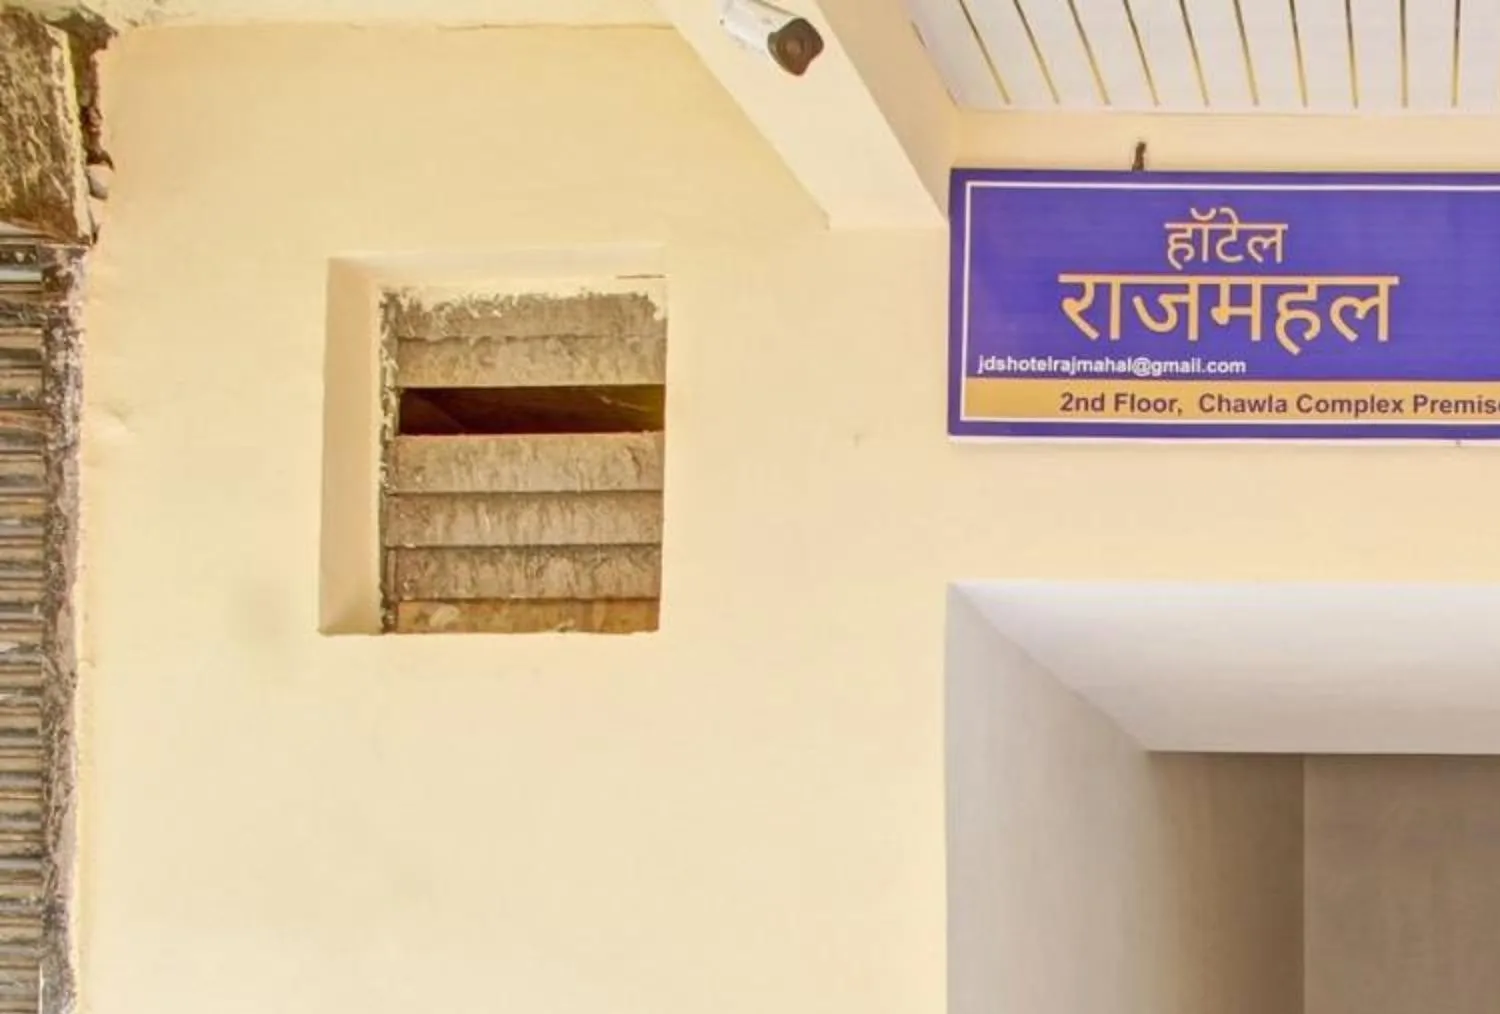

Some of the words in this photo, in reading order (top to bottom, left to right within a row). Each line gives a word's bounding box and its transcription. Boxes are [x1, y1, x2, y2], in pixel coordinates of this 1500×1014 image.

[1164, 207, 1289, 270] हॉटेल
[1058, 273, 1400, 355] राजमहल
[978, 355, 1246, 376] jdshotelrajmahal@gmail.com
[1060, 392, 1105, 412] 2nd
[1114, 393, 1183, 416] Floor,
[1199, 393, 1288, 413] Chawla
[1296, 394, 1404, 419] Complex
